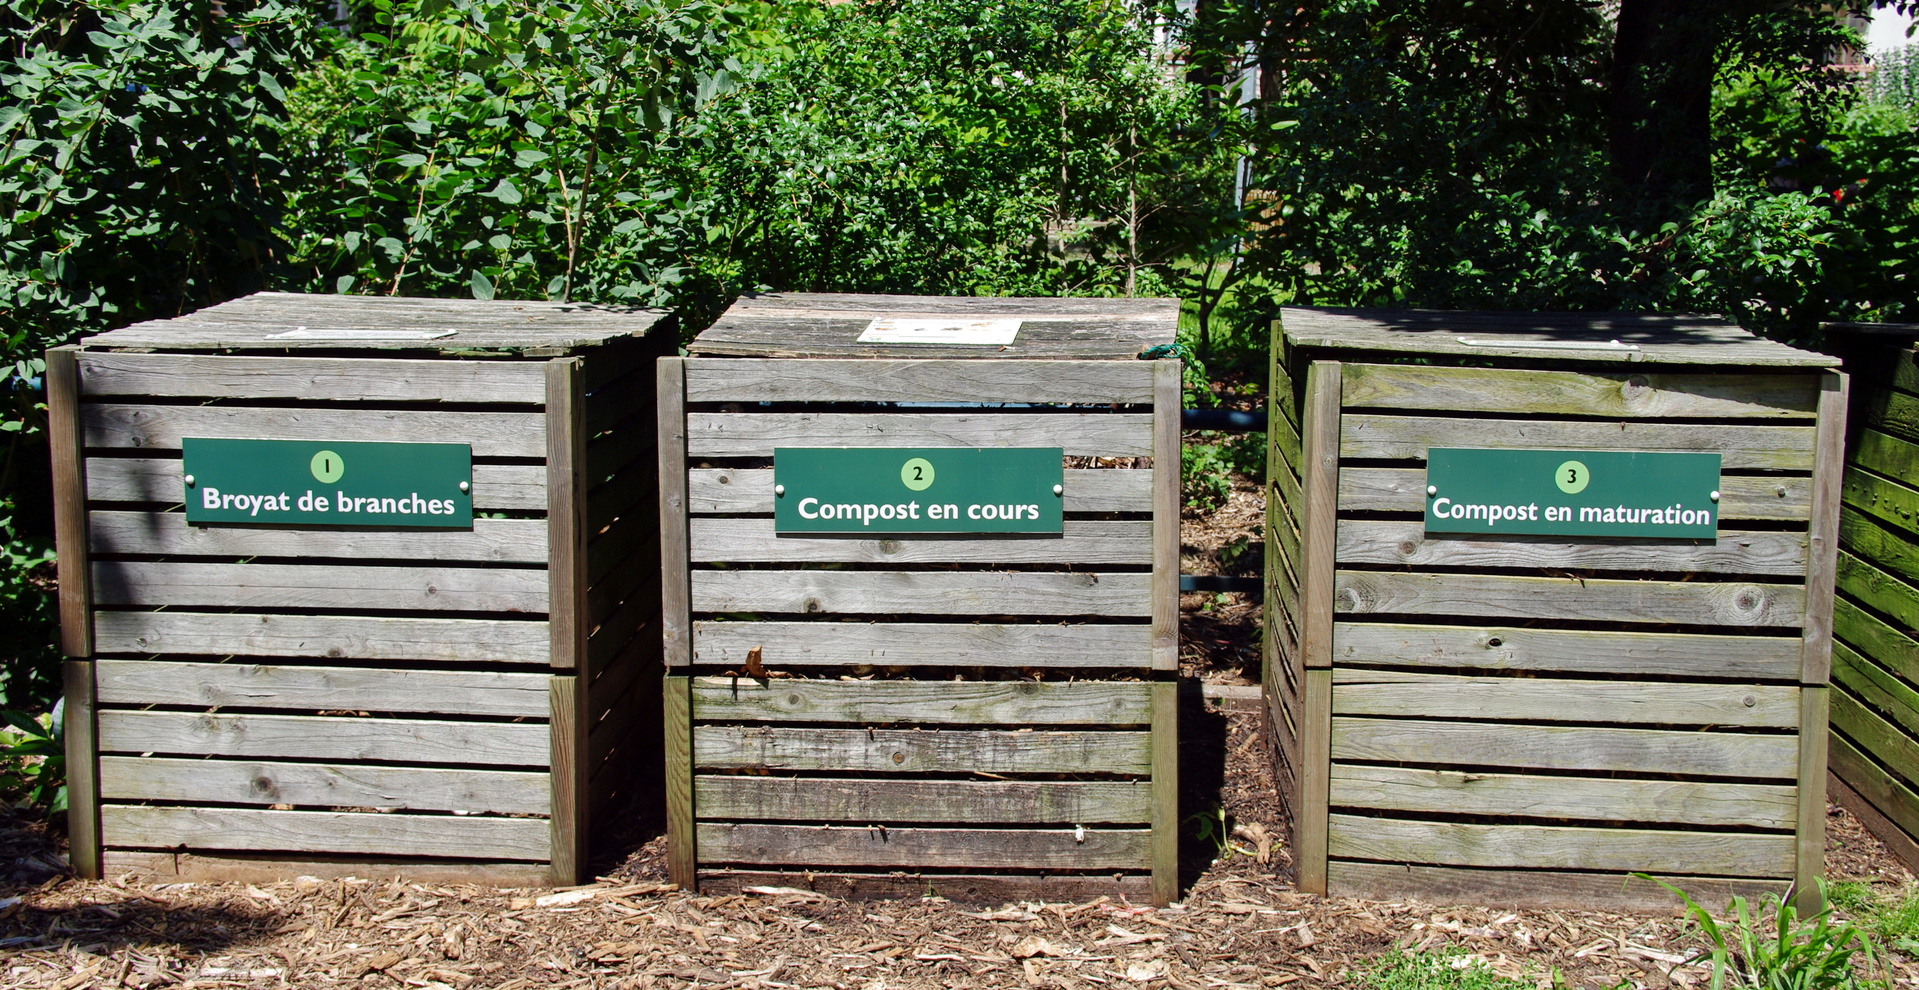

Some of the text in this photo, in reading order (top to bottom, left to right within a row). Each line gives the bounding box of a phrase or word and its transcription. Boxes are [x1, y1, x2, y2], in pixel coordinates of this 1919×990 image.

[913, 466, 923, 481] 2
[1567, 468, 1577, 484] 3
[203, 487, 455, 516] Broyat de branches
[797, 497, 1040, 526] Compost en cours
[1432, 498, 1710, 526] Compost en maturation
